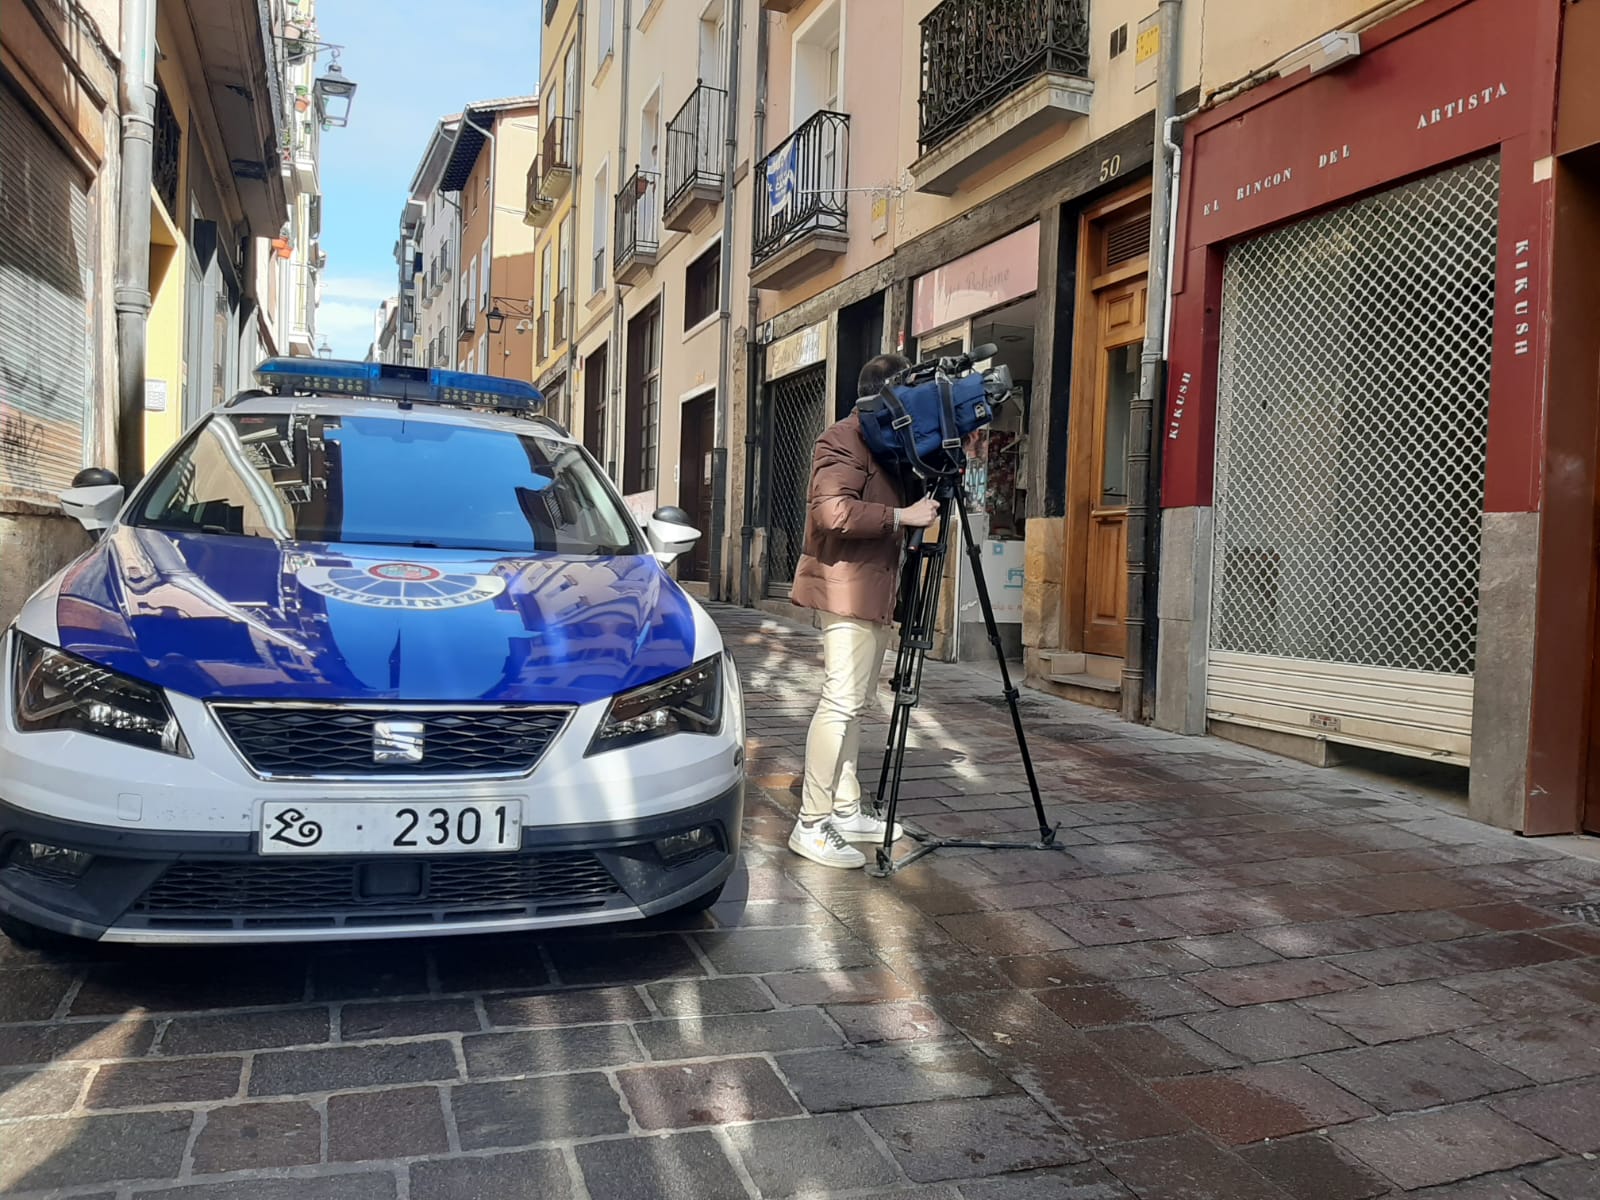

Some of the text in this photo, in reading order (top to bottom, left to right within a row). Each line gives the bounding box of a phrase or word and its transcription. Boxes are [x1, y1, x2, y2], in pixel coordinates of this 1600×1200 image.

[1099, 154, 1120, 182] 50
[1203, 82, 1508, 216] EL RINCON DEL ARTISTA
[1514, 239, 1529, 355] KIKUSH
[1169, 372, 1191, 439] KIKUSH
[314, 583, 493, 607] ERTZAINTZA
[393, 805, 506, 847] 2301
